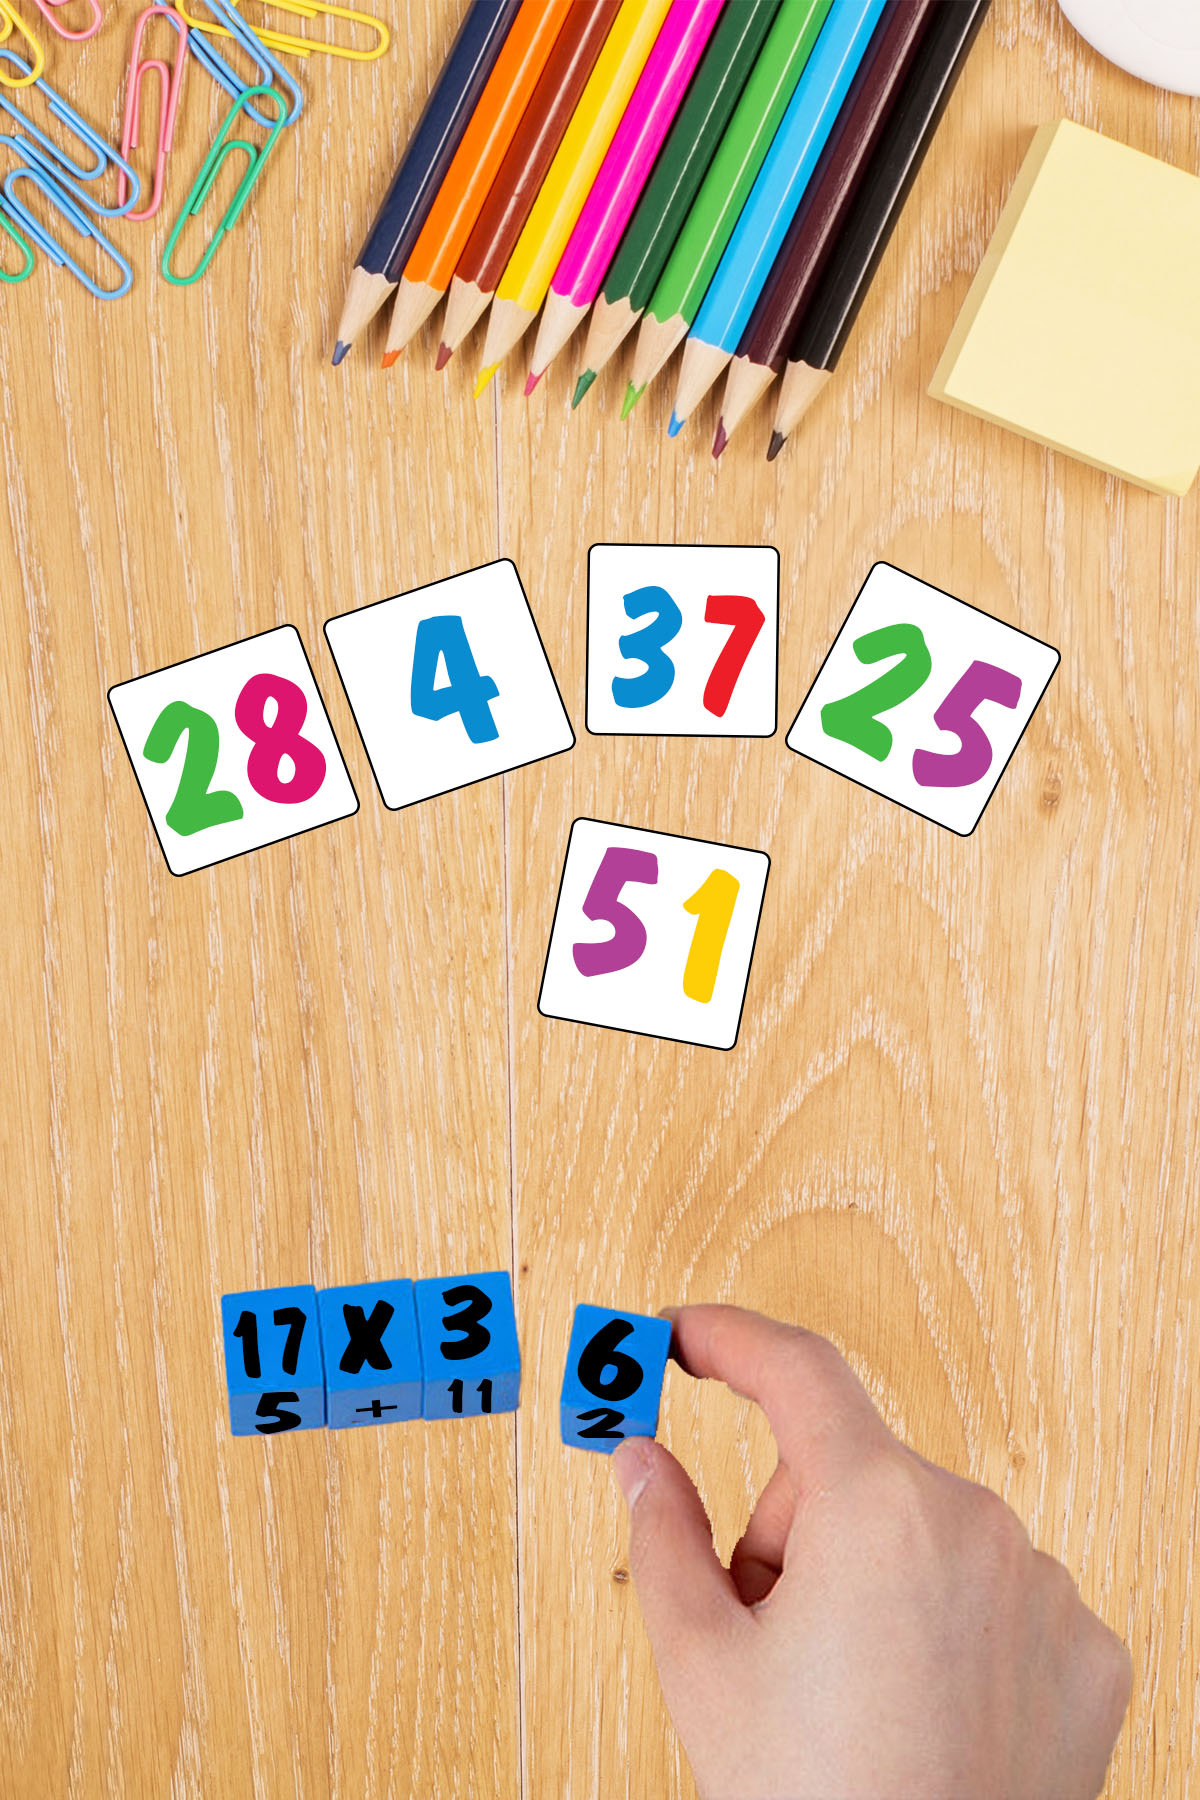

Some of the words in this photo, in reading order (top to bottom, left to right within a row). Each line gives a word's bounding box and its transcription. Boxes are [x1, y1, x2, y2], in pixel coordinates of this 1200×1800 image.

[411, 616, 499, 743] 4
[612, 586, 765, 717] 37
[821, 624, 1021, 787] 25
[144, 673, 326, 836] 28
[573, 848, 740, 1003] 51
[233, 1307, 306, 1378] 17
[440, 1285, 492, 1360] 3
[578, 1319, 643, 1401] 6
[256, 1392, 301, 1434] 5
[448, 1379, 492, 1413] 11
[577, 1408, 624, 1438] 2
